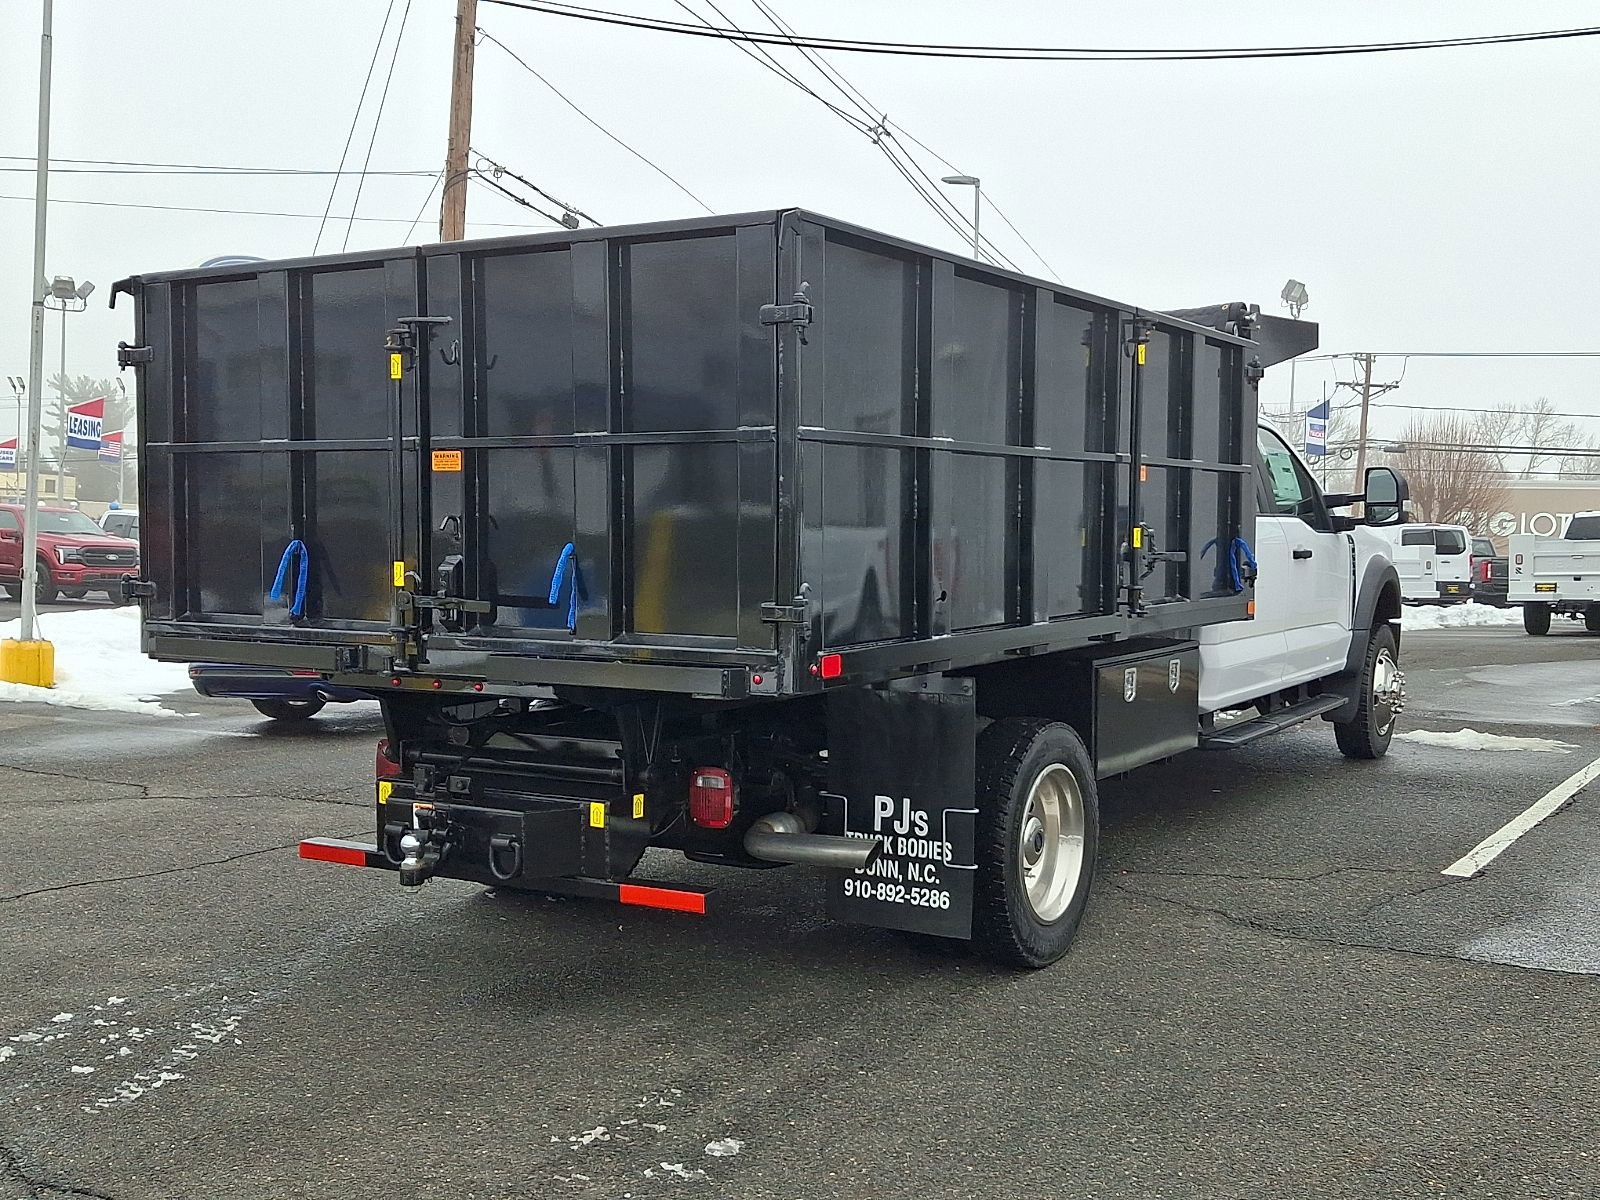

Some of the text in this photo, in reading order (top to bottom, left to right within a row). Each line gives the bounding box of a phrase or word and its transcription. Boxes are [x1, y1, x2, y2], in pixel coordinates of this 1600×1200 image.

[68, 416, 101, 438] LEASING
[897, 836, 953, 862] BODIES
[907, 862, 941, 885] N.C.
[844, 878, 951, 910] 910-892-5286
